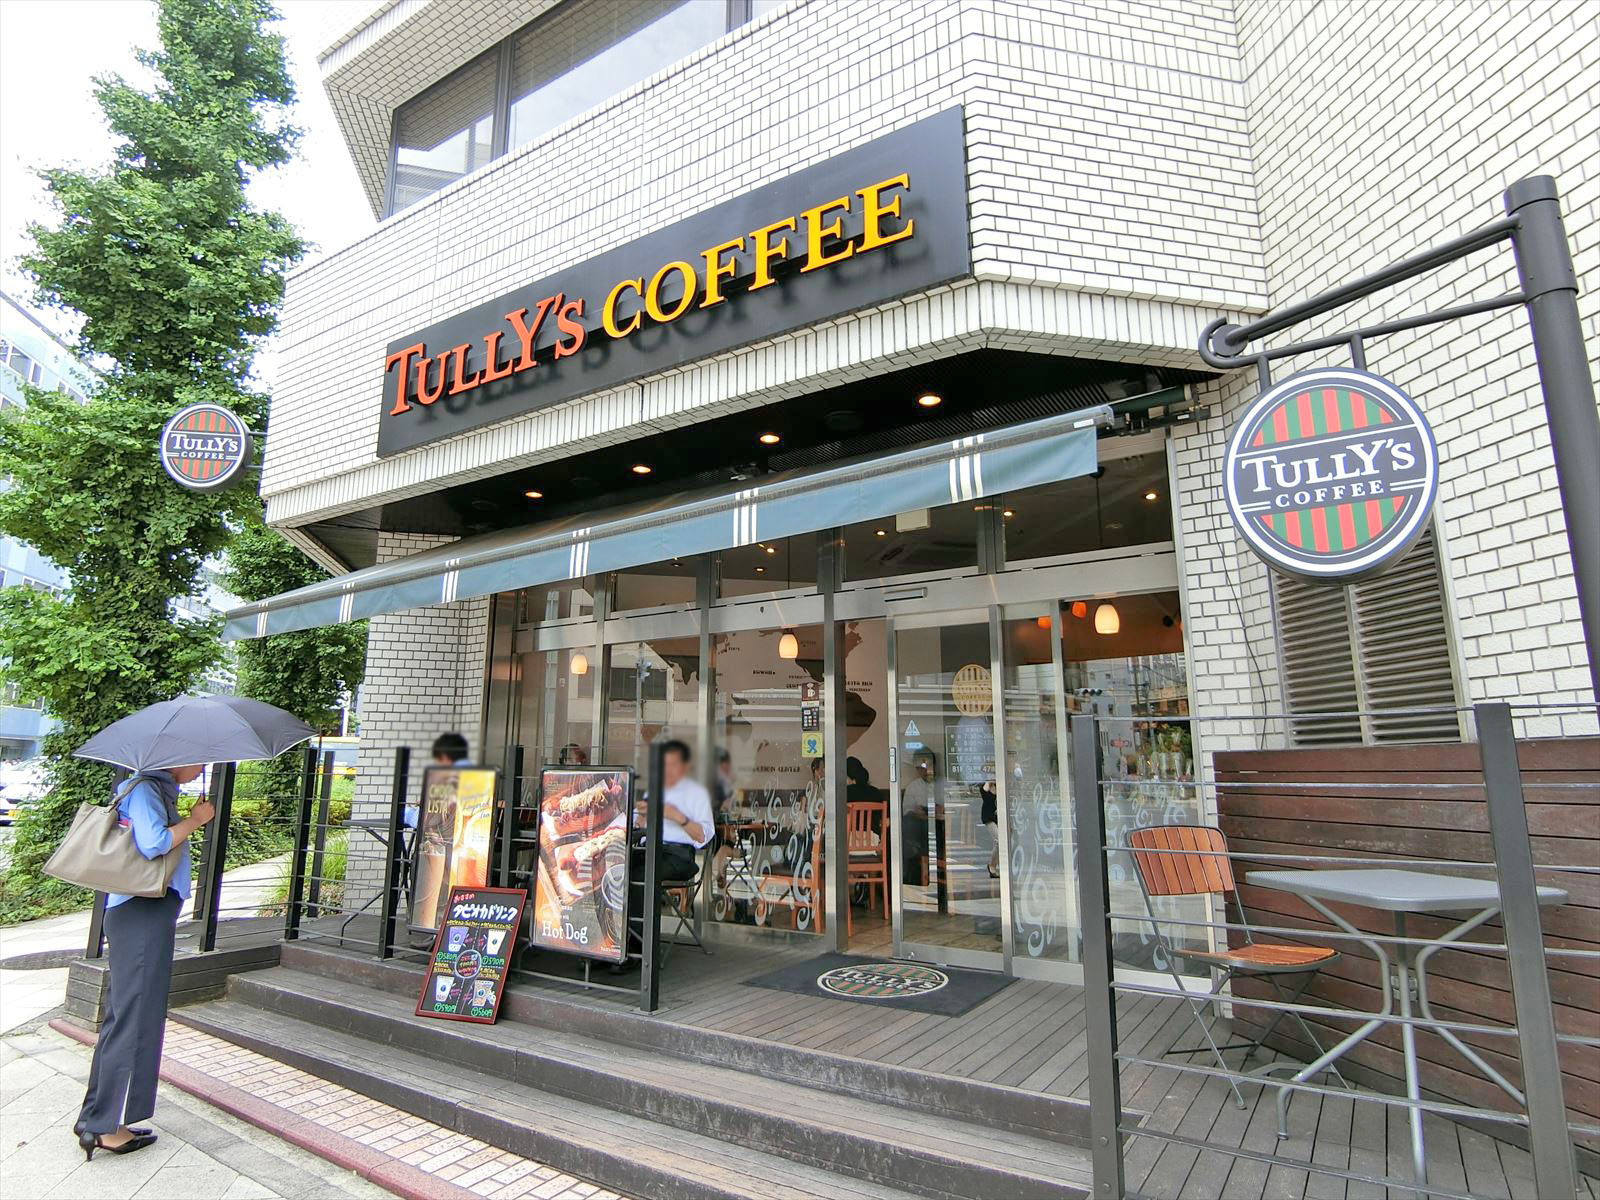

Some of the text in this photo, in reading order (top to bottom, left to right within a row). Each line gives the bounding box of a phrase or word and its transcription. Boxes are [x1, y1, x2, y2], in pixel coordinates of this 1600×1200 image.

[385, 173, 915, 417] TULLY'S COFFEE
[171, 433, 238, 452] TULLY'S
[181, 451, 224, 460] COFFEE
[1241, 438, 1416, 493] TULLY'S
[1275, 480, 1385, 508] COFFEE
[453, 903, 518, 922] タピオカドリンク
[542, 919, 588, 944] Hot Dog
